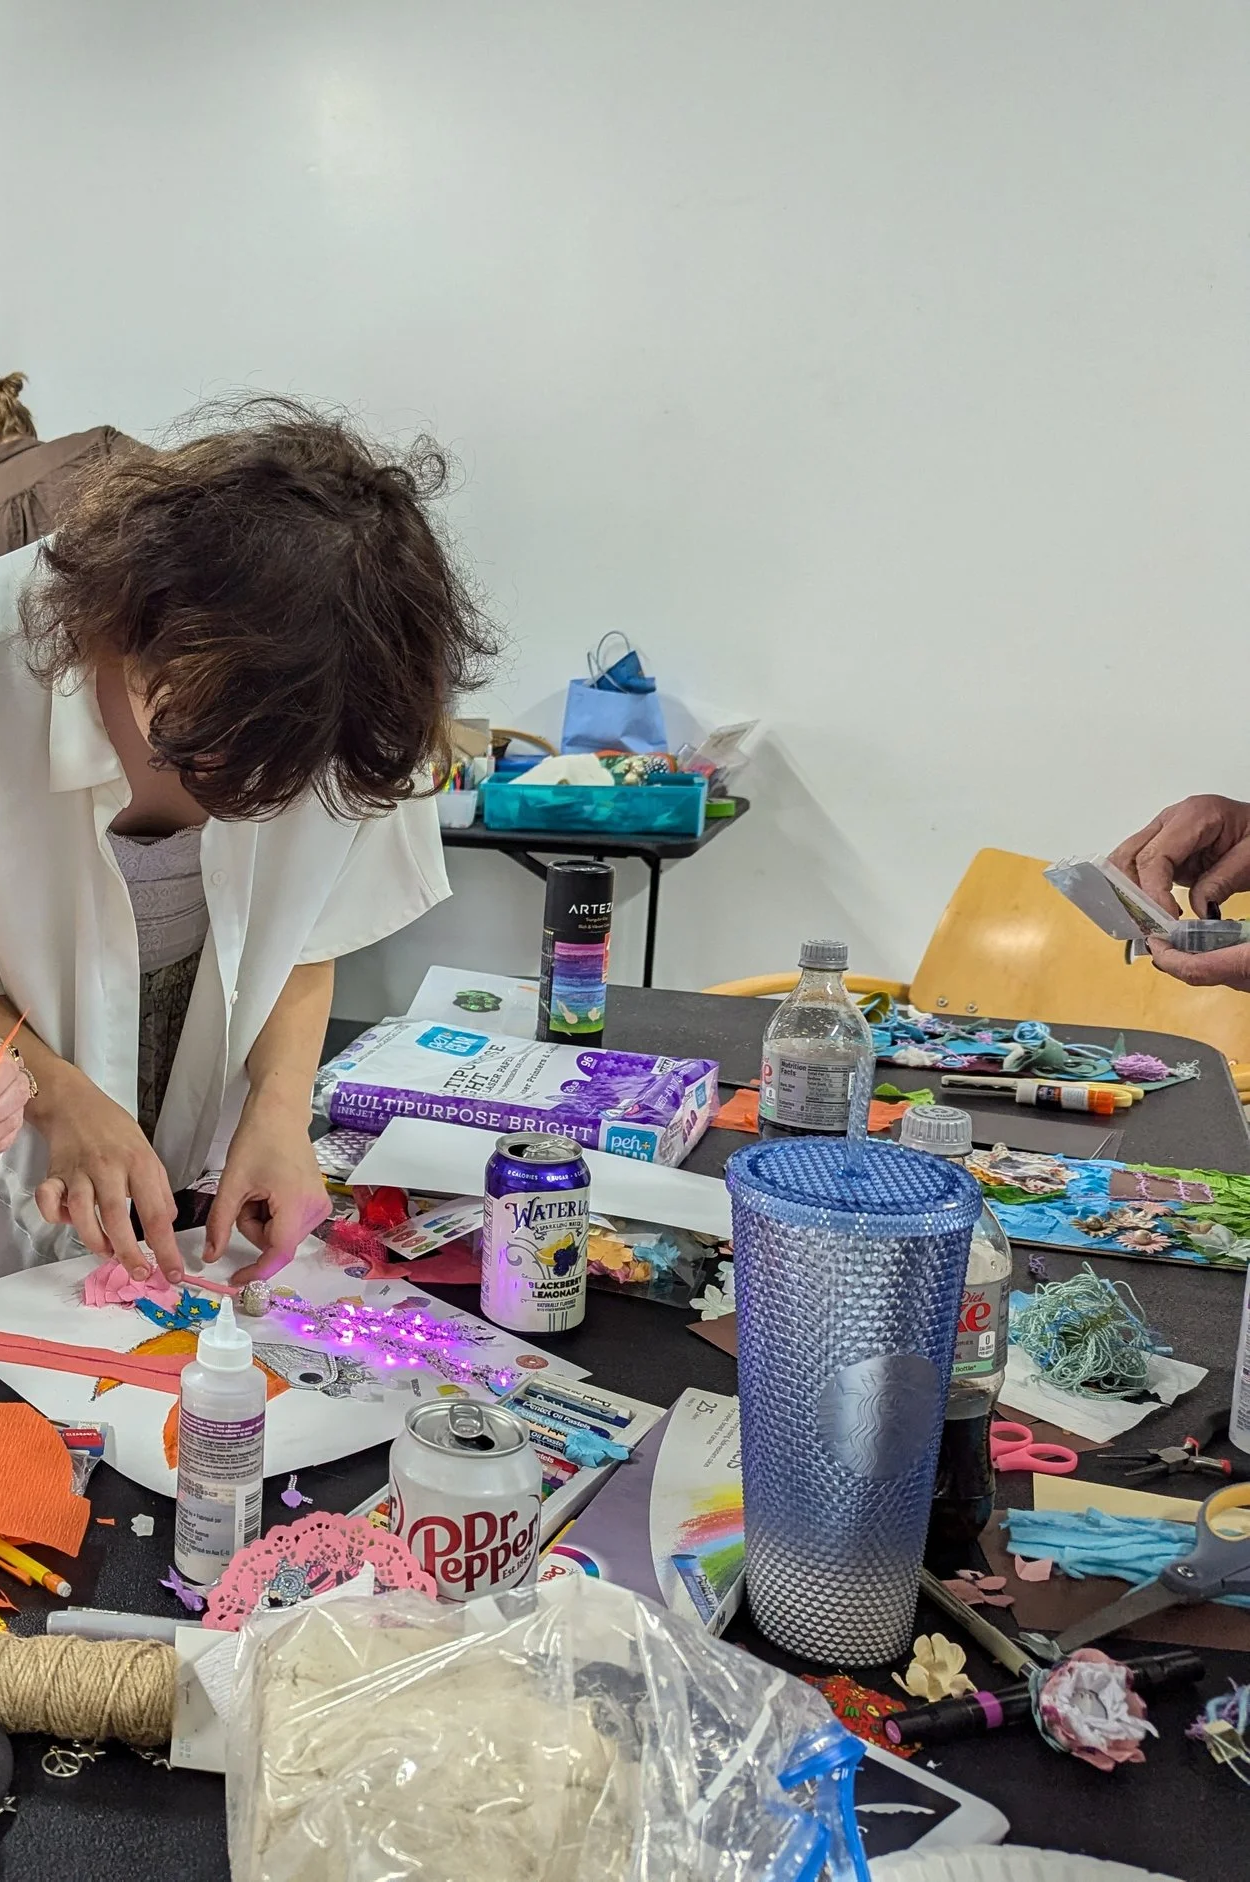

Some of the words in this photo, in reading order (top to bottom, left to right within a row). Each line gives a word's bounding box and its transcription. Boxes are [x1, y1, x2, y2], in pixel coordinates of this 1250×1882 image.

[581, 1055, 594, 1068] 96
[781, 1061, 807, 1072] Nutrition
[780, 1067, 797, 1076] Facts
[337, 1106, 375, 1119] INKJET
[338, 1091, 501, 1128] MULTIPURPOSE
[507, 1115, 593, 1143] BRIGHT
[512, 1171, 538, 1180] CALORIES
[505, 1196, 590, 1233] WATERLO
[539, 1222, 568, 1231] SPARKLING
[528, 1275, 582, 1290] BLACKBERRY
[532, 1285, 580, 1299] LEMONADE
[962, 1290, 985, 1303] Diet
[985, 1334, 991, 1345] 0
[696, 1400, 718, 1414] 25
[522, 1400, 552, 1416] Pentel
[552, 1411, 564, 1420] Oil
[563, 1416, 591, 1431] Pastels
[530, 1431, 542, 1440] Oil
[462, 1510, 519, 1554] Dr
[408, 1511, 539, 1593] Pepper
